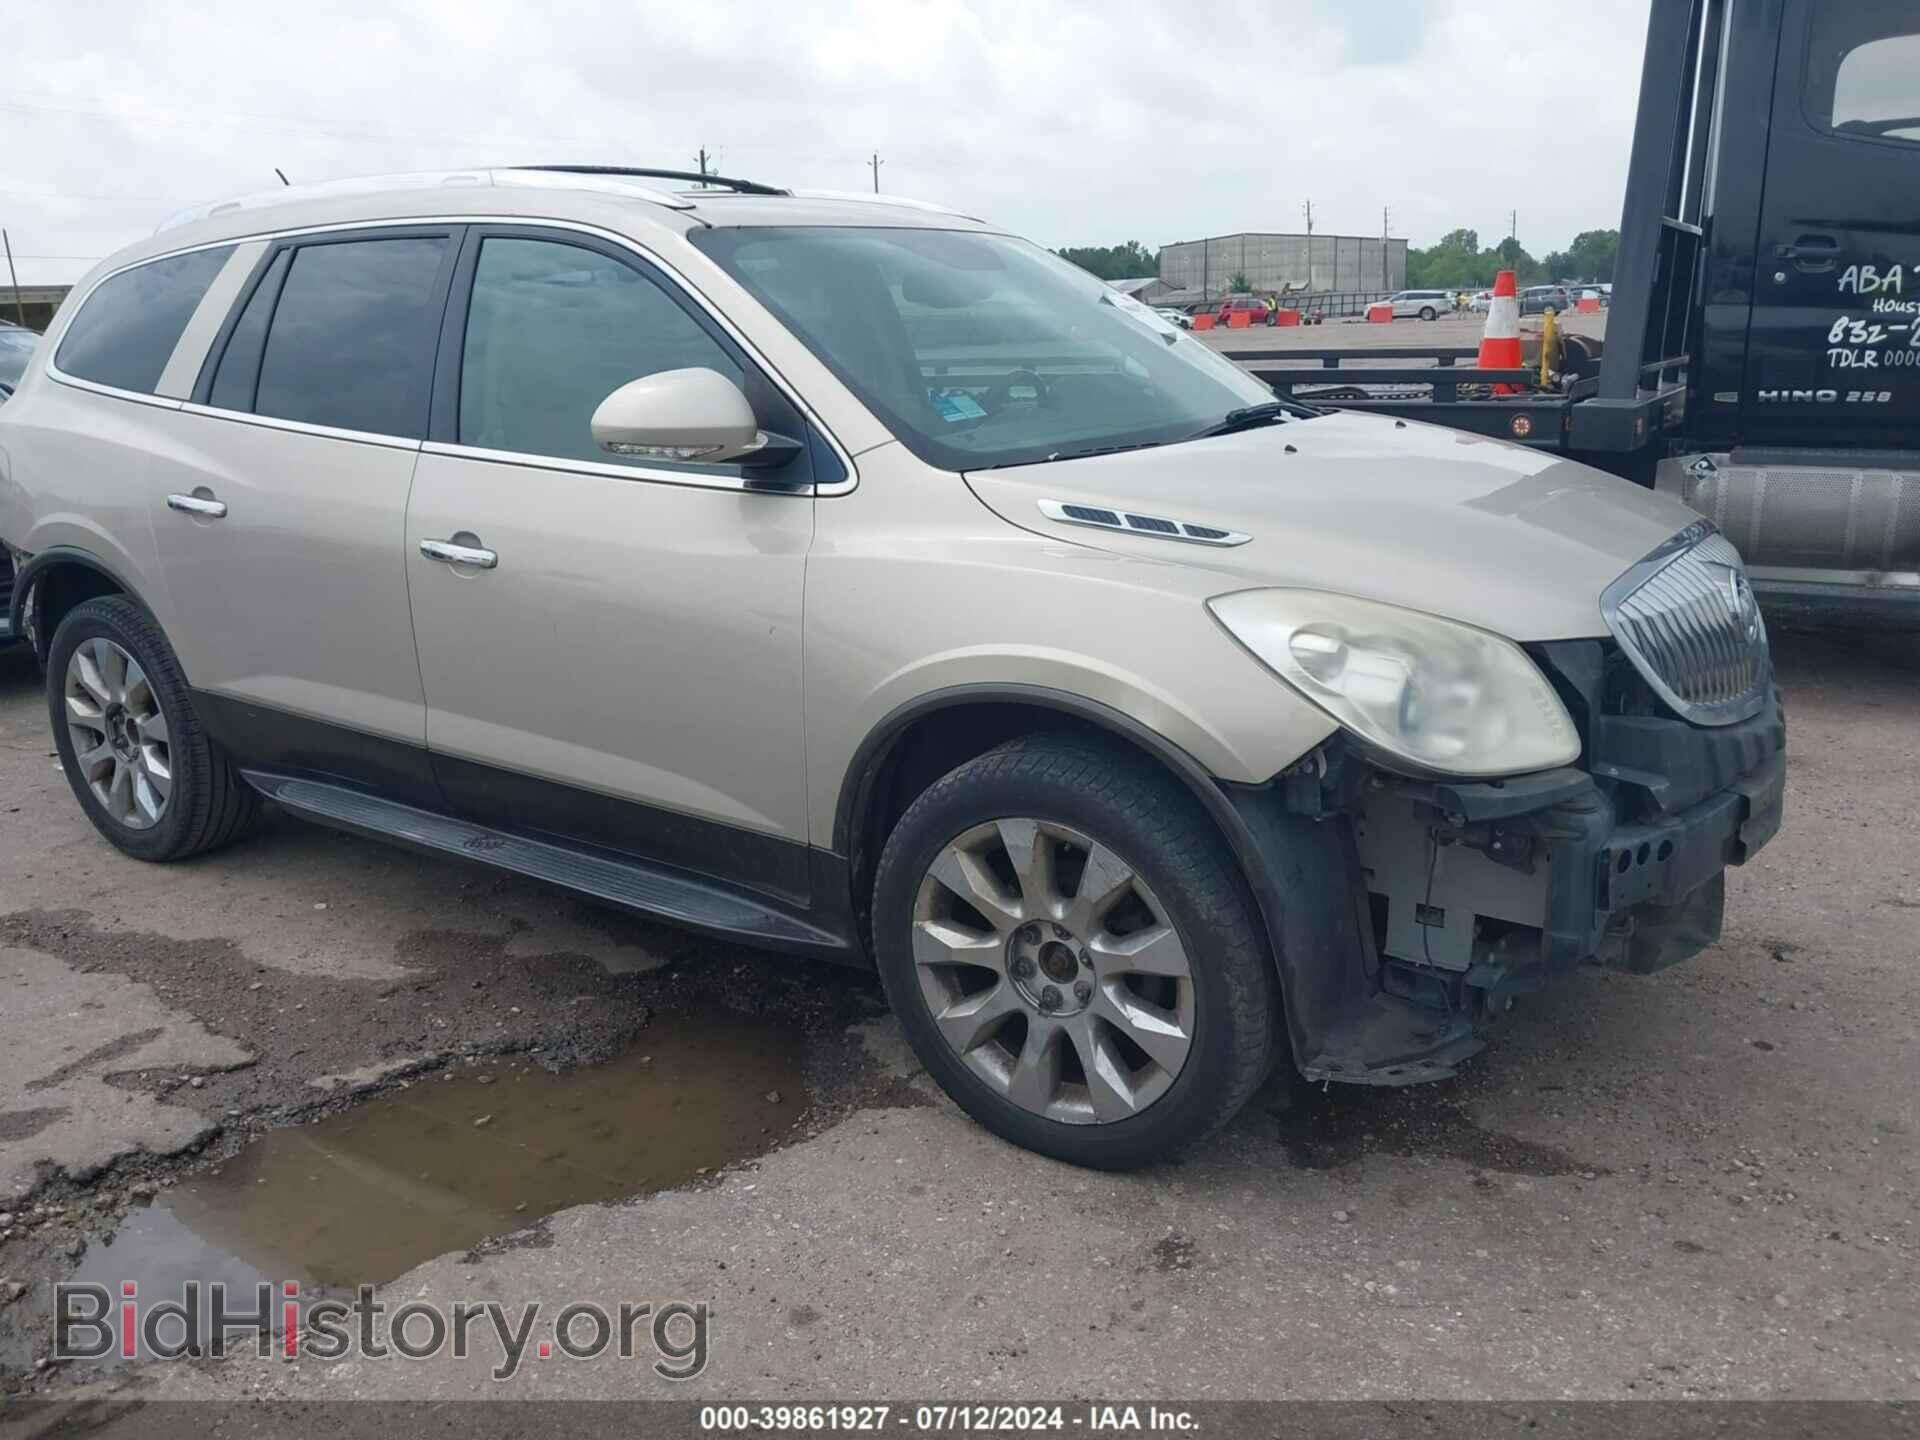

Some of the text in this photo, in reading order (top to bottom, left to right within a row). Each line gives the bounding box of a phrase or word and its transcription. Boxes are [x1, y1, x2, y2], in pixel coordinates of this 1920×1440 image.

[1838, 265, 1902, 294] ABA
[1827, 348, 1878, 368] TDLR
[1758, 389, 1892, 402] HINO 258
